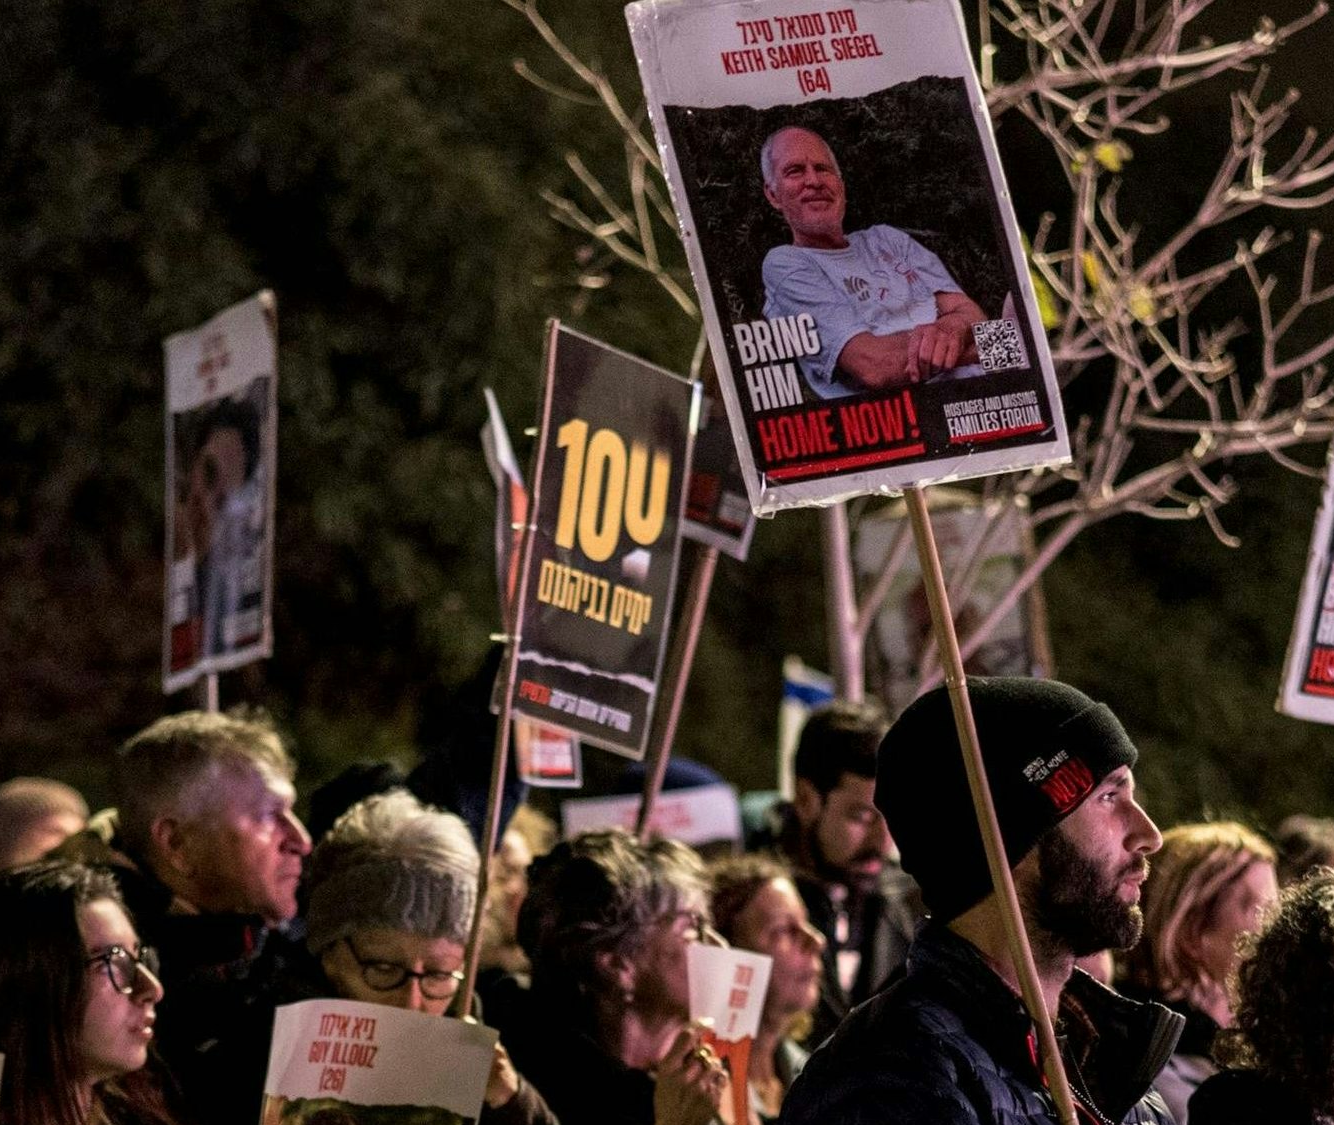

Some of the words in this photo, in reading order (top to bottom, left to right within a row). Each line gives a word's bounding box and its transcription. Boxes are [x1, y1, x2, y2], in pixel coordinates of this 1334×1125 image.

[736, 20, 774, 45] סיגל
[774, 13, 825, 41] סמואל
[826, 9, 858, 34] קית
[721, 48, 767, 75] KEITH
[767, 40, 830, 70] SAMUEL
[831, 34, 883, 61] SIEGEL
[797, 66, 831, 96] (64)
[733, 313, 820, 366] BRING
[745, 361, 804, 412] HIM
[943, 398, 984, 418] HOSTAGES
[984, 395, 1002, 412] AND
[1001, 390, 1038, 409] MISSING
[757, 409, 838, 462] HOME
[840, 389, 921, 449] NOW!
[947, 411, 999, 438] FAMILIES
[1000, 404, 1042, 430] FORUM
[537, 560, 610, 623] בגיהנום
[610, 583, 653, 636] ימים
[331, 1042, 378, 1068] ILLOUZ
[319, 1065, 347, 1094] (26)
